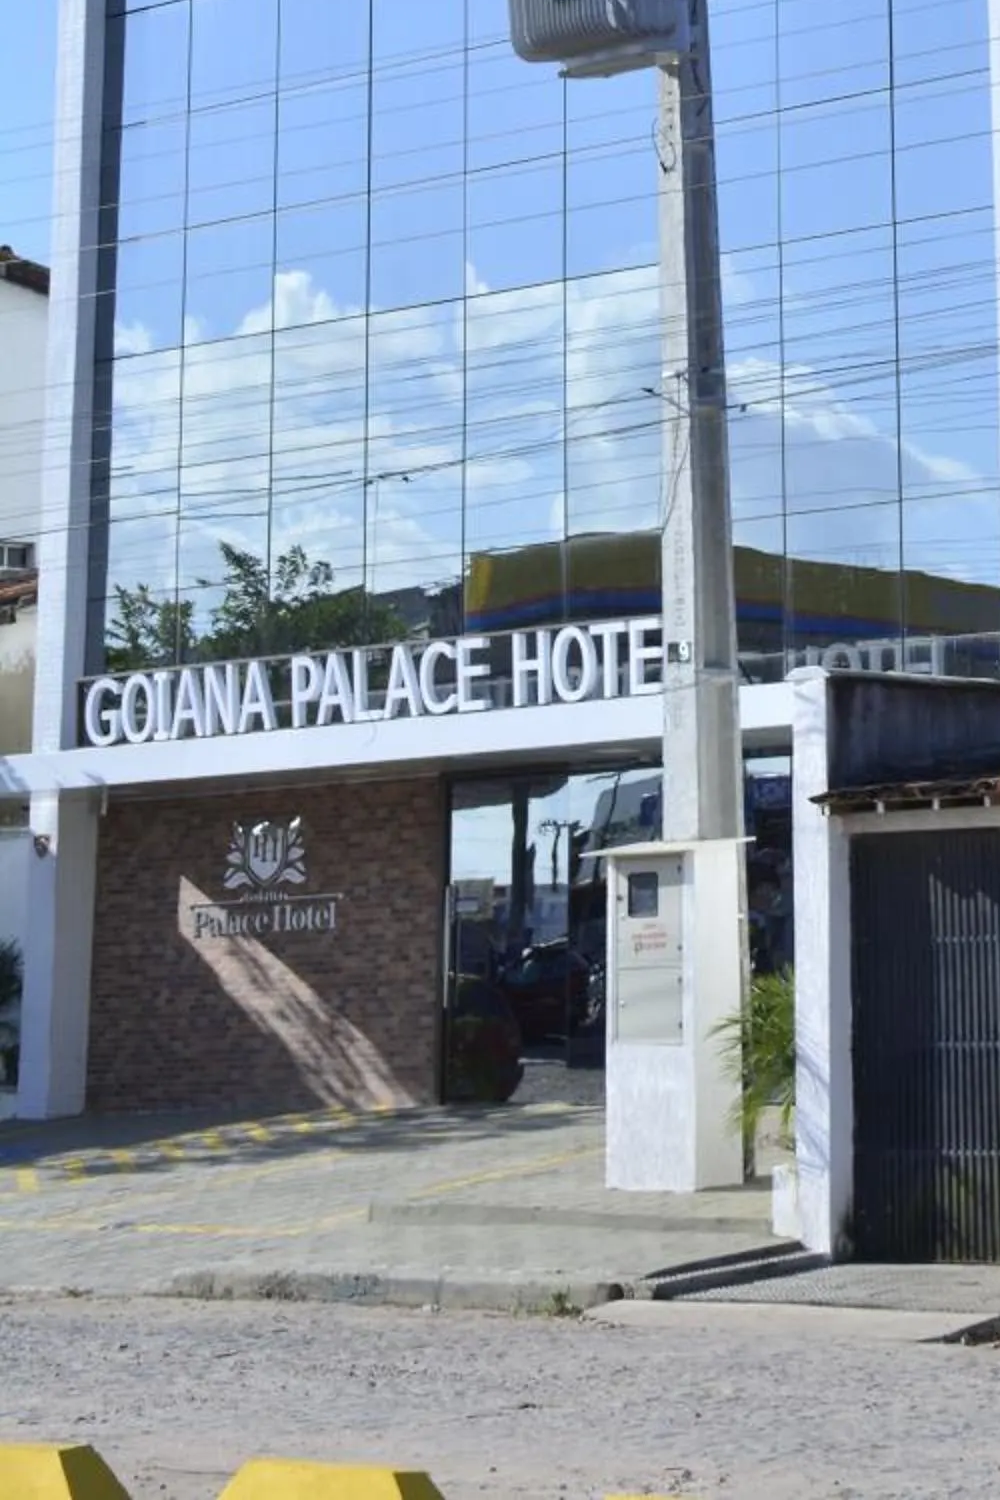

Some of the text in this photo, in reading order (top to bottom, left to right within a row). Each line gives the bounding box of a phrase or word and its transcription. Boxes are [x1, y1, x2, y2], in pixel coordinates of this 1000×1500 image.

[83, 617, 663, 746] GOIANA PALACE HOTE
[193, 901, 337, 938] Palace Hotel
